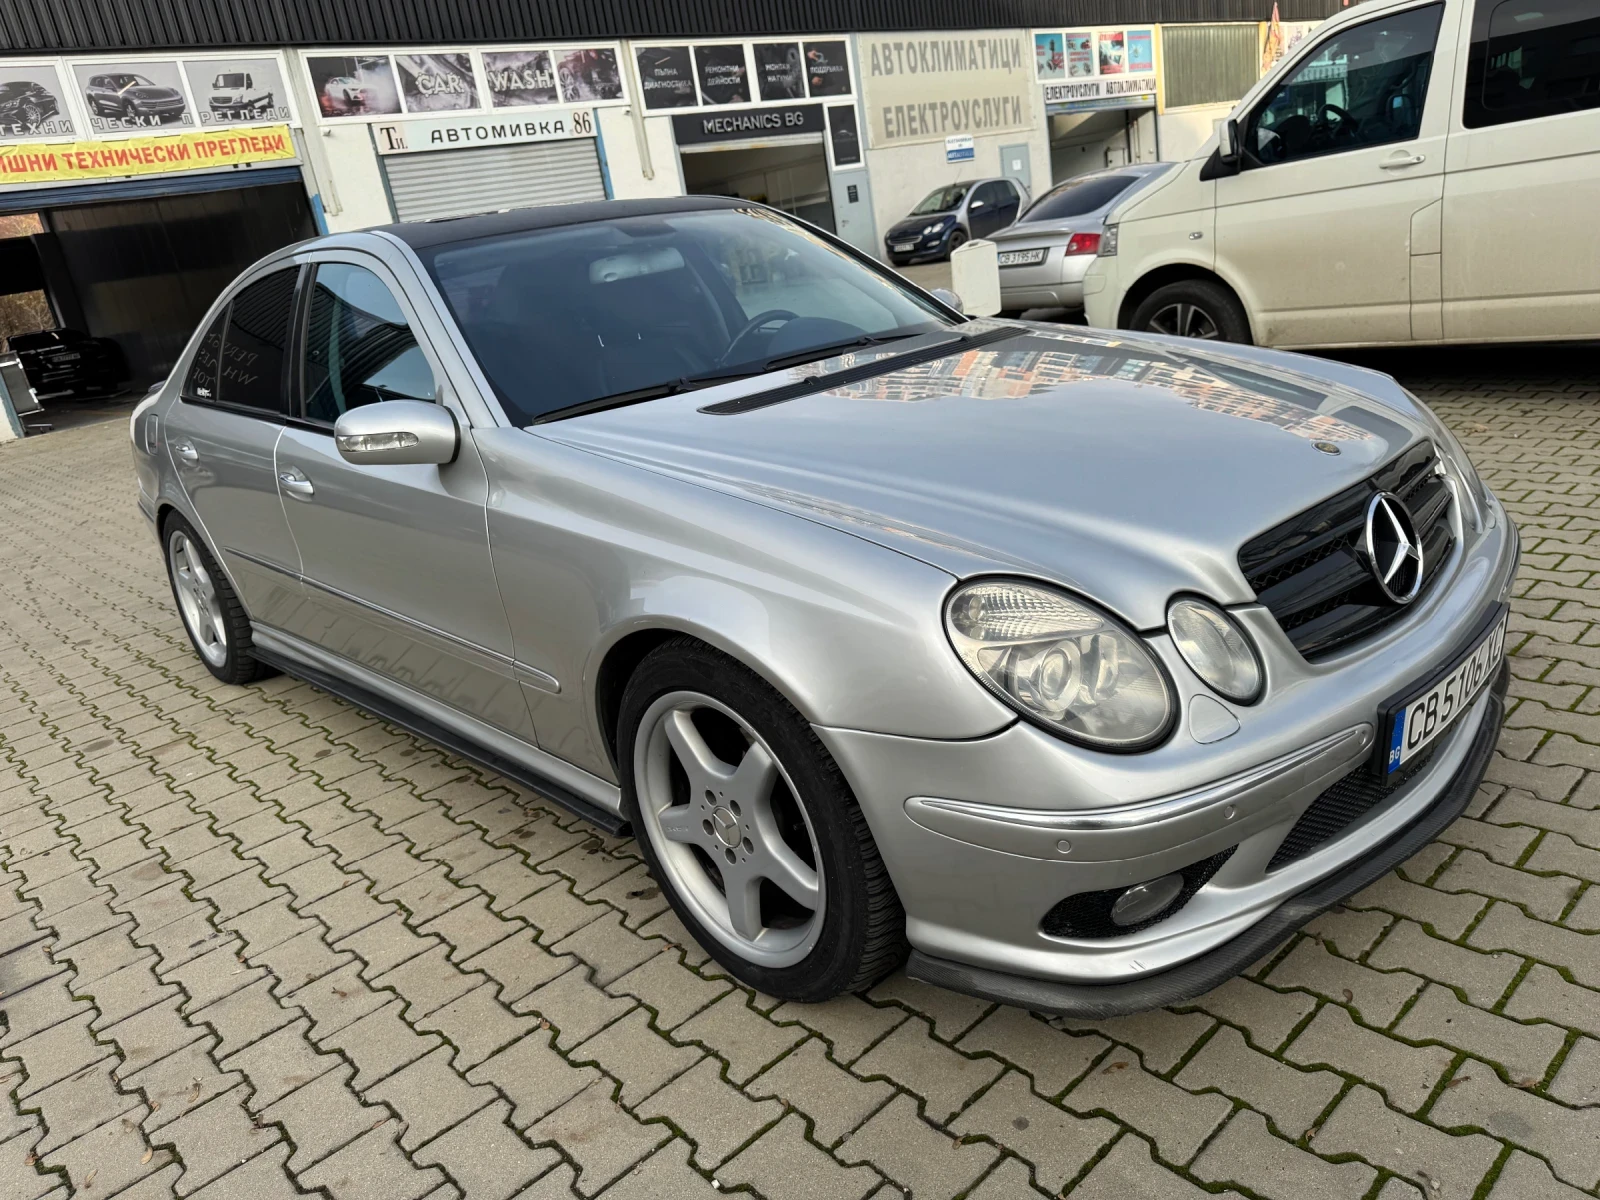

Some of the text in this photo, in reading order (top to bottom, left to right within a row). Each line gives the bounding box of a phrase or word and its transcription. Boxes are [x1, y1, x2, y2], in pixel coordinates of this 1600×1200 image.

[870, 37, 1021, 77] АВТОКЛИМАТИЦИ
[416, 68, 552, 96] CAR WASH
[1045, 83, 1101, 100] ЕЛЕКТРОУСЛУГИ
[431, 119, 565, 144] АВТОМИВКА
[573, 111, 592, 134] 86
[703, 112, 804, 134] MECHANICS BG
[883, 96, 1022, 139] ЕЛЕКТРОУСЛУГИ
[61, 143, 191, 170] ТЕХНИЧЕСКИ
[194, 134, 286, 158] ПРЕГЛЕДИ
[1389, 745, 1400, 764] BG
